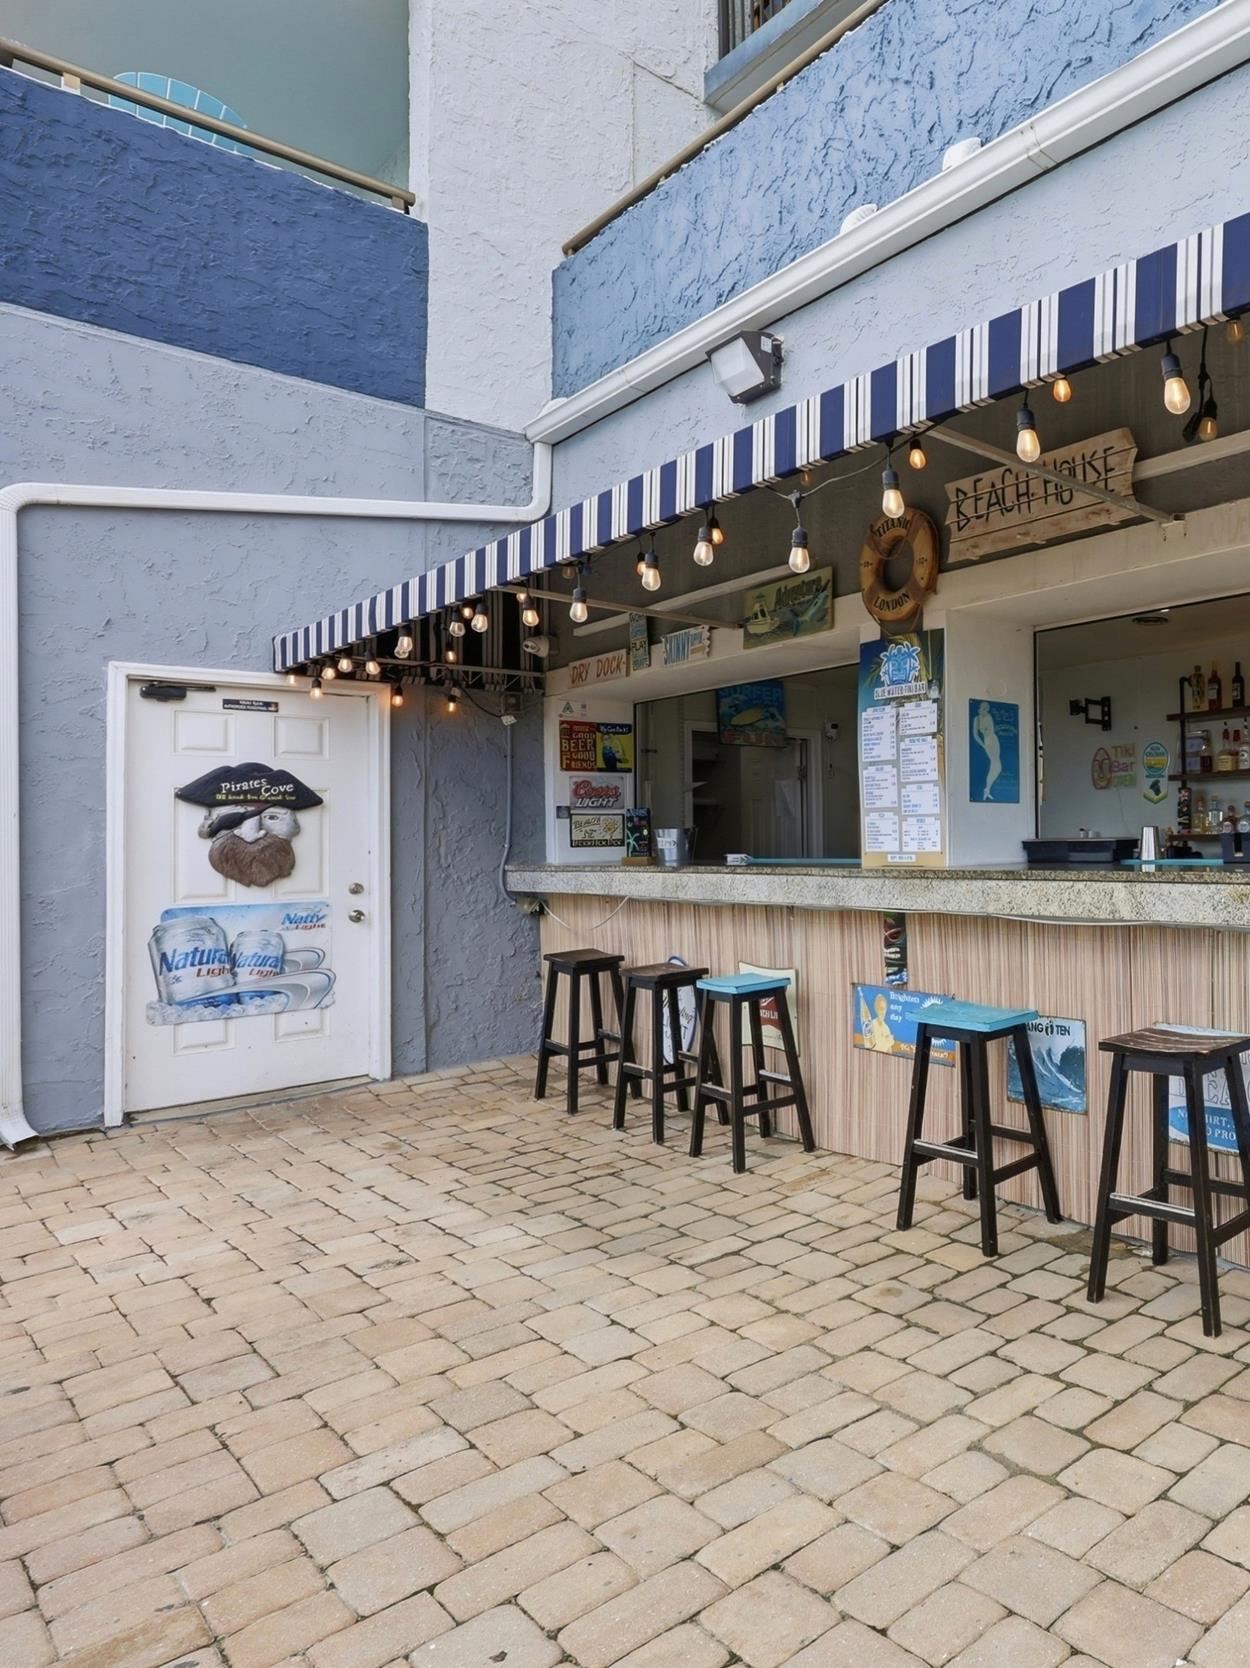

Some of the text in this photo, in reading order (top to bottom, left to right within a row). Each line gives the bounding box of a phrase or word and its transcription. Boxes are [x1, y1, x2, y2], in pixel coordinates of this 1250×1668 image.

[956, 468, 1033, 532] BEACH
[873, 591, 910, 611] LONDON
[571, 661, 591, 684] DRY
[596, 655, 623, 678] DOCK
[562, 739, 595, 752] BEER
[220, 778, 268, 794] Pirates
[261, 783, 294, 797] Cove
[575, 798, 619, 808] LIGHT
[281, 912, 328, 926] Natty
[159, 946, 231, 976] Natura
[232, 951, 281, 970] Natura
[195, 965, 232, 978] Ligh
[248, 967, 279, 978] Ligh
[1026, 1022, 1071, 1036] ANG TEN
